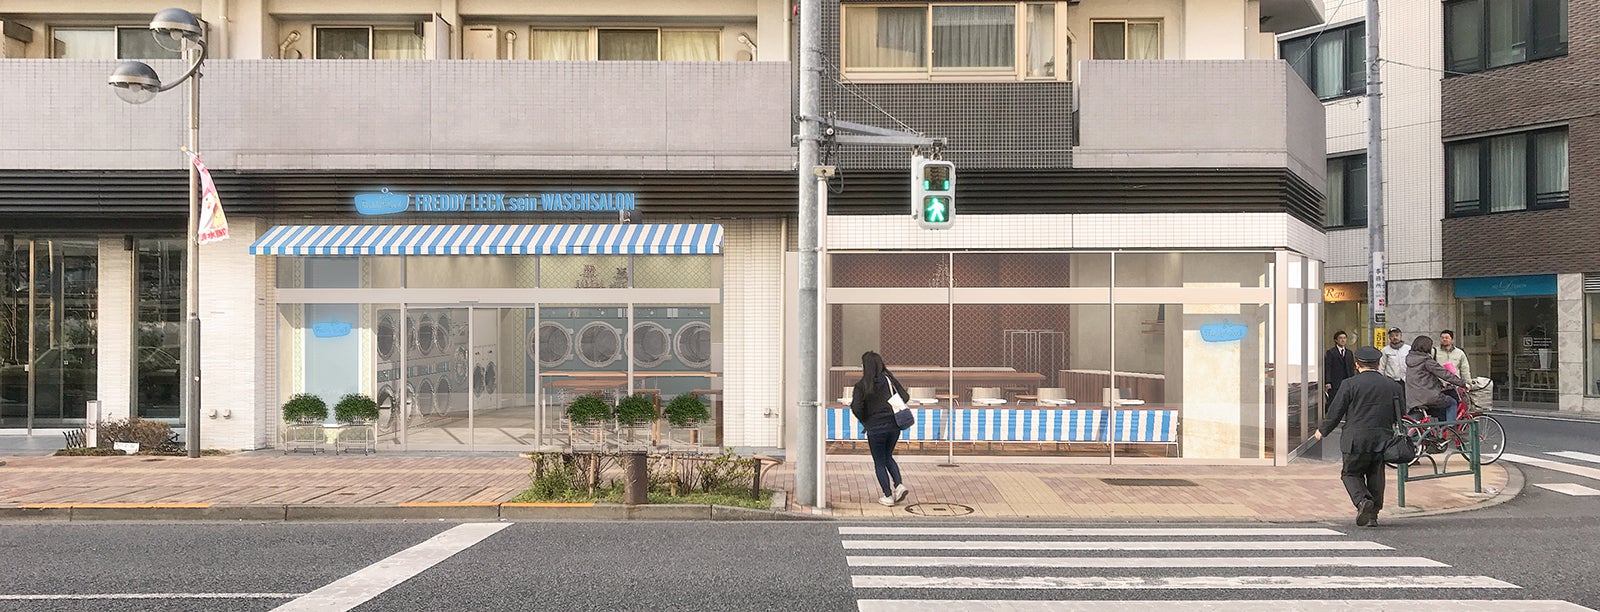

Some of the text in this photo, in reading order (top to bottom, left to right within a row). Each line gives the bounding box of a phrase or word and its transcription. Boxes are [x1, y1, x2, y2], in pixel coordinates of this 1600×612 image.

[415, 193, 468, 212] FREDDY
[471, 193, 506, 212] LECK
[508, 194, 538, 212] sein
[541, 192, 635, 211] WASCHSALON
